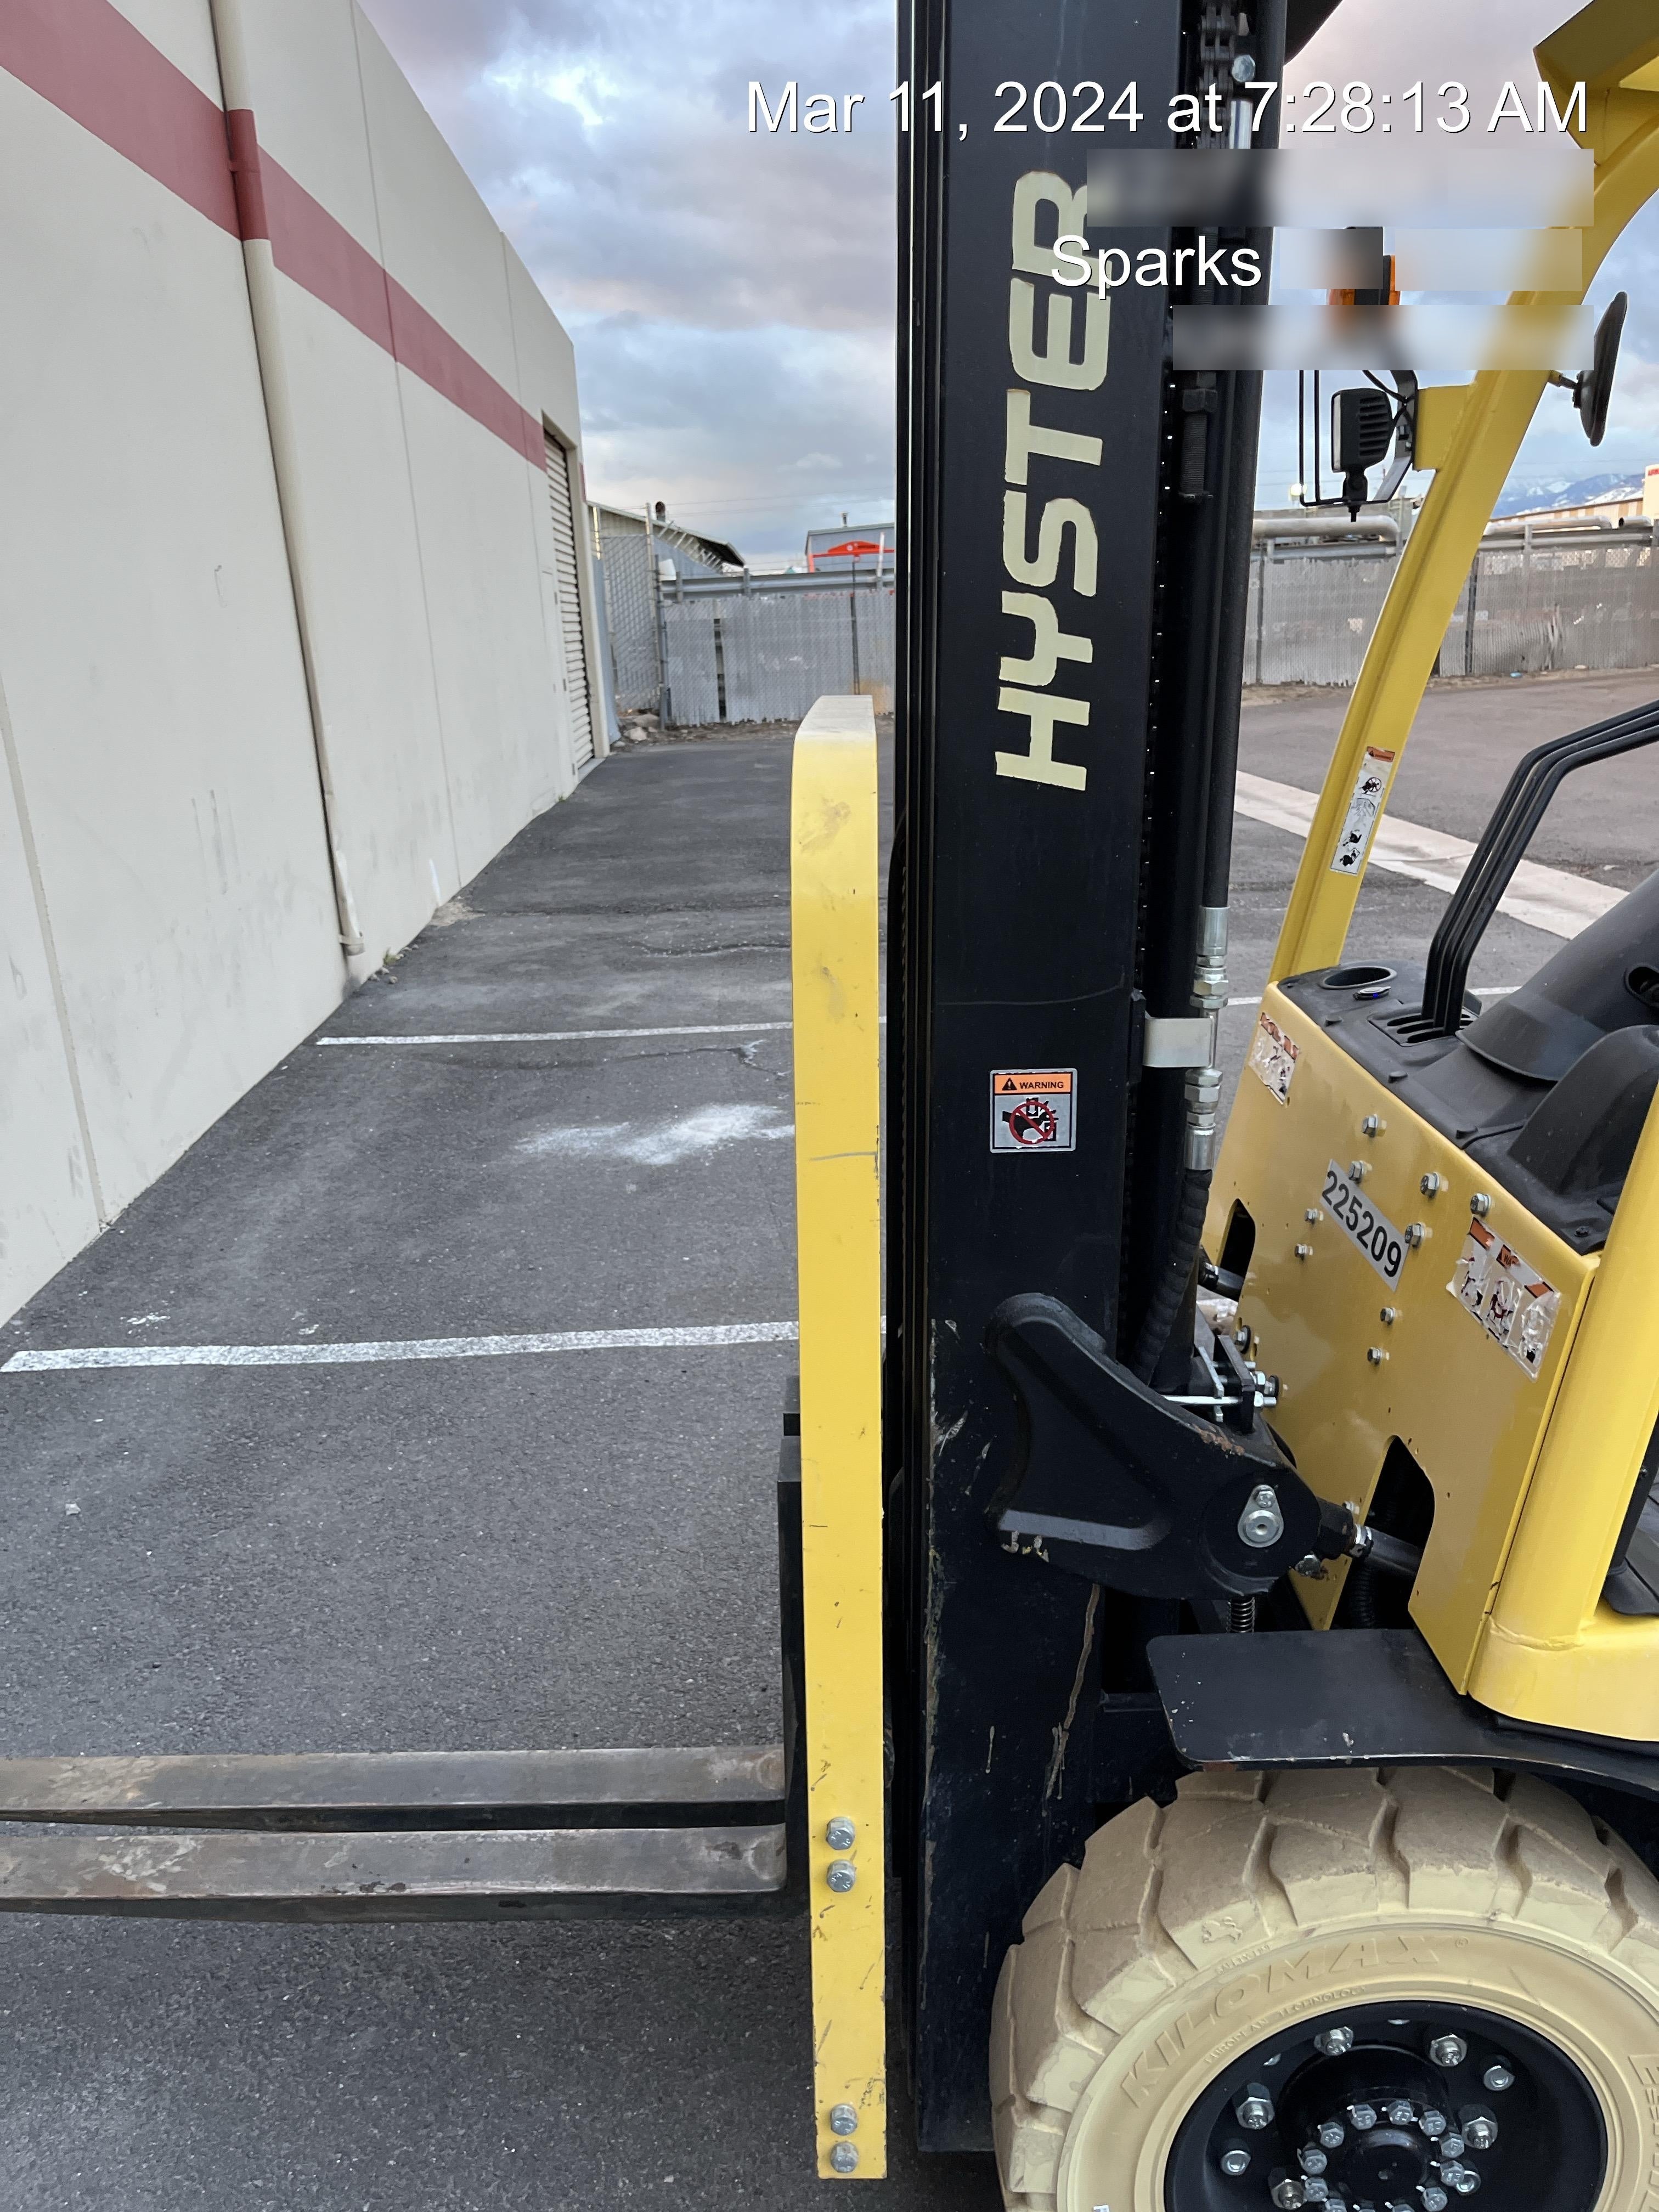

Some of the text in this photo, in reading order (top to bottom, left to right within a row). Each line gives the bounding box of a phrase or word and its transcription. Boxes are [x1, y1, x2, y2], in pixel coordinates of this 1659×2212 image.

[995, 170, 1112, 792] HYSTER
[1019, 1081, 1064, 1090] WARNING
[1322, 1170, 1401, 1277] 225209
[1121, 1934, 1453, 2108] KILOMAX
